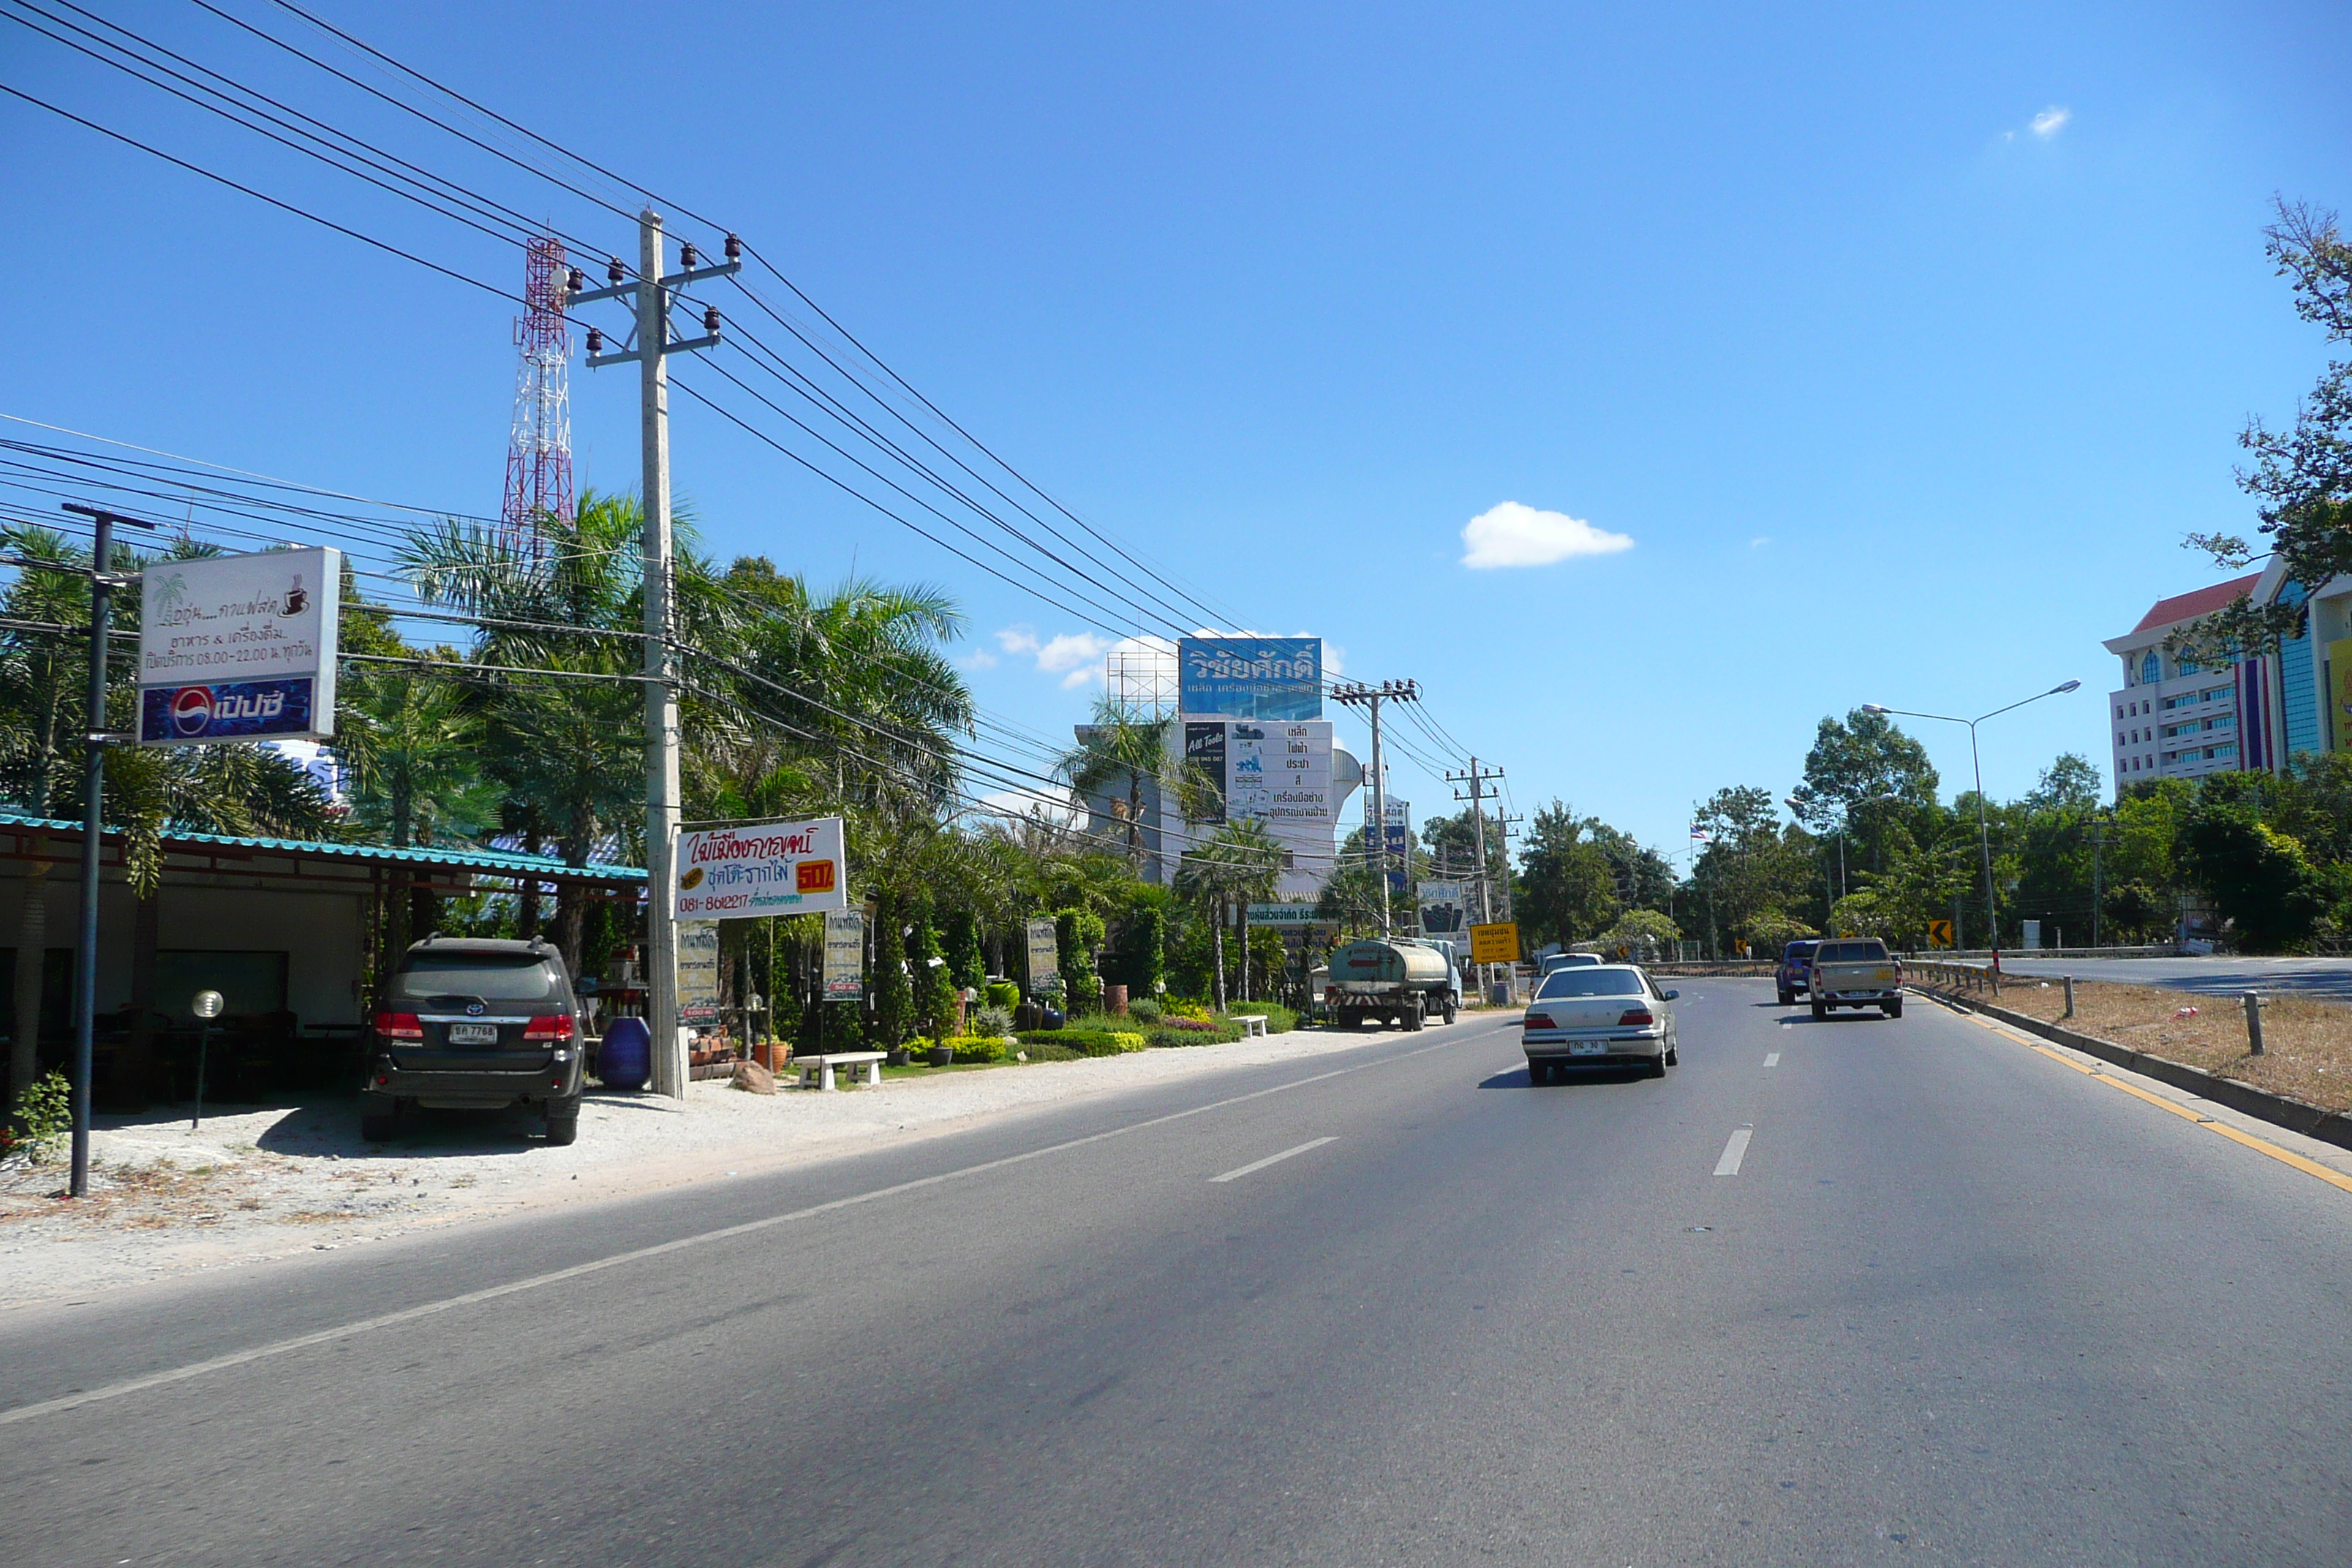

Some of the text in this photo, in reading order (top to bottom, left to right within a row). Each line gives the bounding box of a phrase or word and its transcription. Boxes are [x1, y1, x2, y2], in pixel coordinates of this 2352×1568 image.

[171, 634, 210, 649] อาหาร
[214, 636, 224, 644] &
[1188, 644, 1316, 679] วิชัยศักดิ์
[1288, 725, 1307, 736] เหล็ก
[1188, 732, 1224, 753] All Tools
[1287, 741, 1308, 753] ไฟฟ้า
[1286, 758, 1309, 769] ประปา
[1295, 774, 1301, 785] สี
[1273, 790, 1323, 802] เครื่องมือช่าง
[797, 862, 834, 889] 50%
[679, 894, 748, 913] 081-8612217
[471, 1026, 493, 1036] 7768
